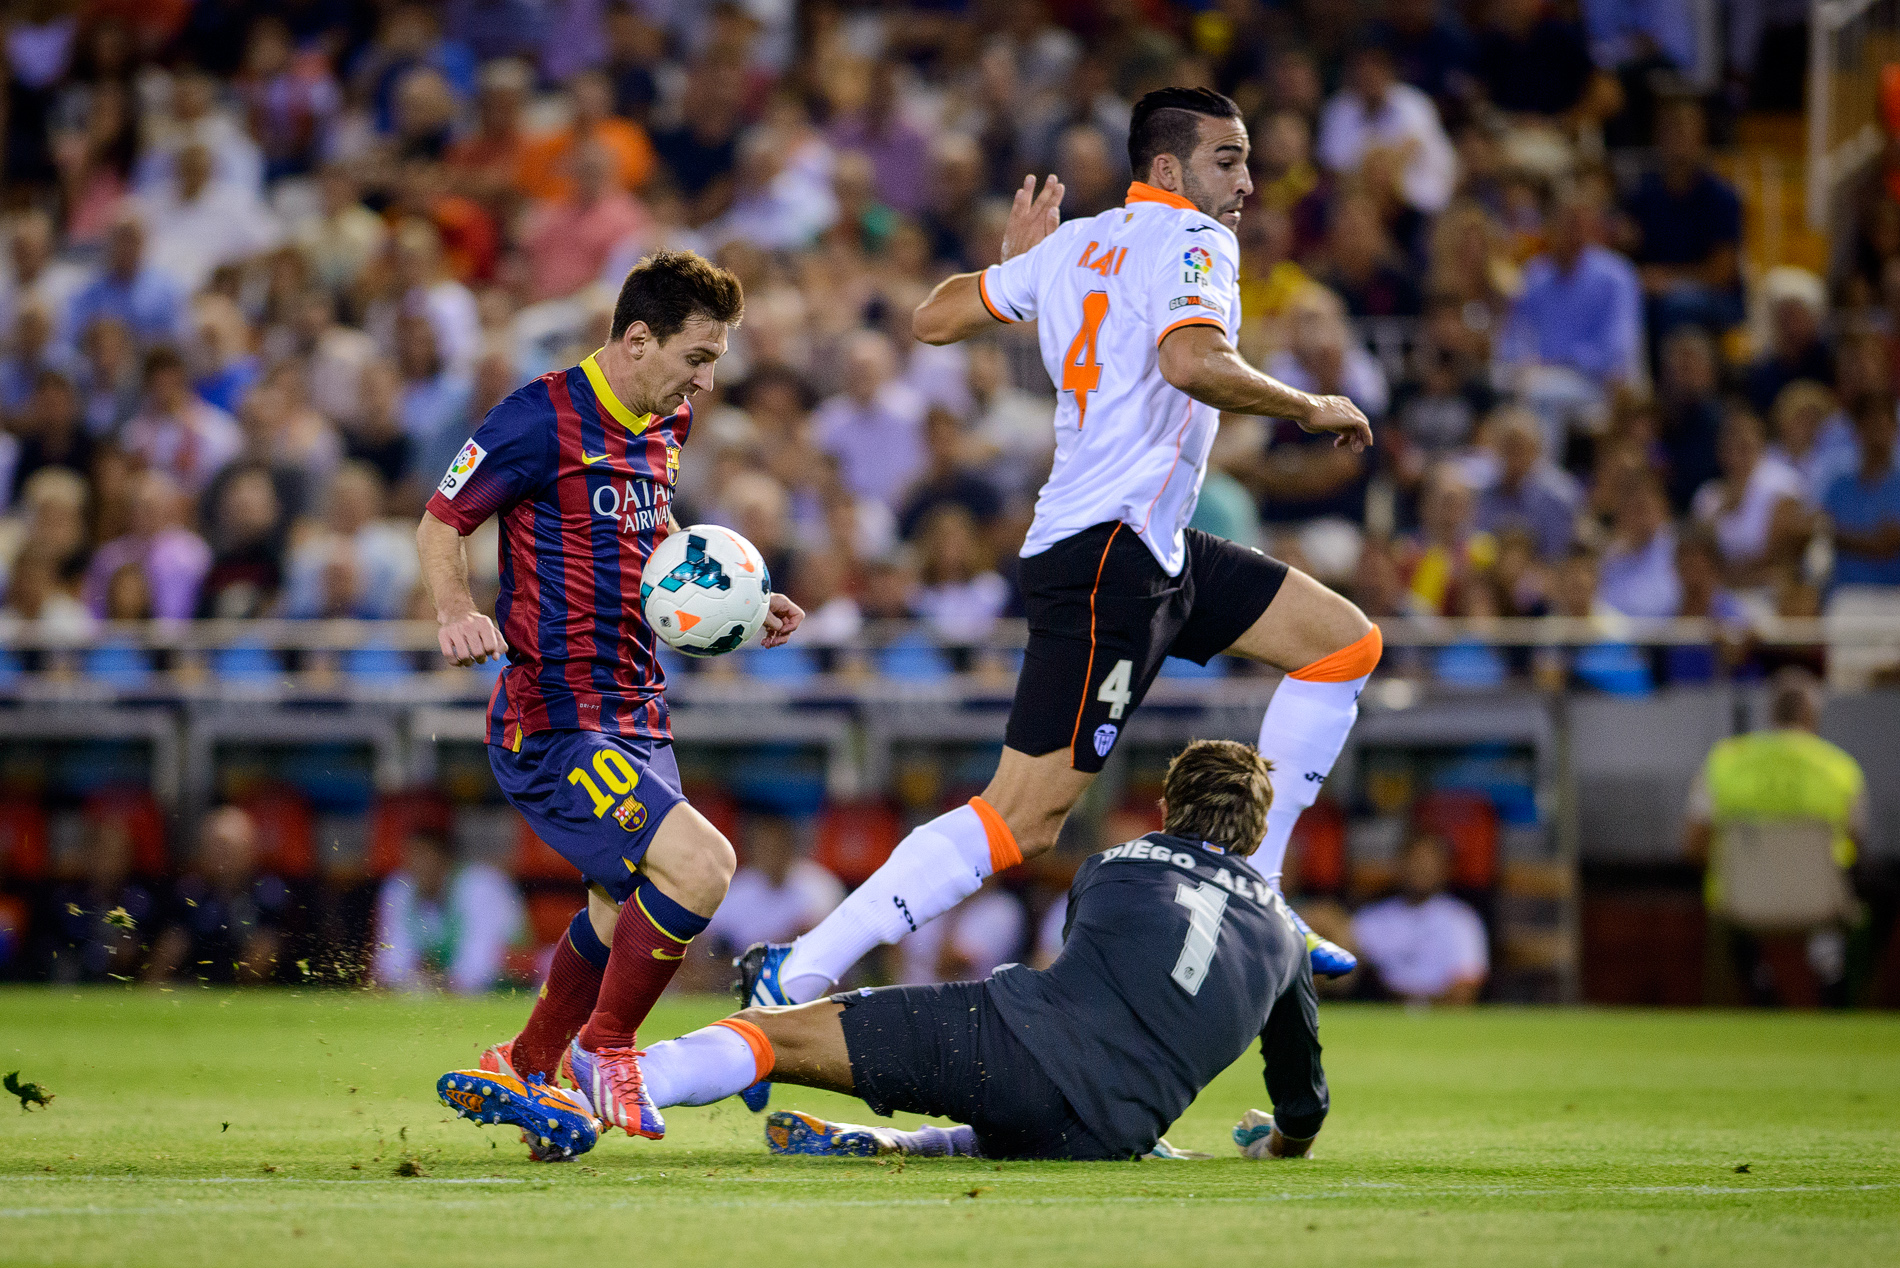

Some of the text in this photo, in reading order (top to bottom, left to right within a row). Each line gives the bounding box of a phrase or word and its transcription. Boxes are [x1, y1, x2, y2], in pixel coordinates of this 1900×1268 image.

[1062, 290, 1109, 431] 4
[440, 474, 456, 491] FP
[623, 501, 672, 533] AIRWAY
[1097, 659, 1133, 719] 4
[567, 748, 639, 819] 10
[1100, 840, 1196, 869] DIEGO
[1170, 881, 1230, 997] 1
